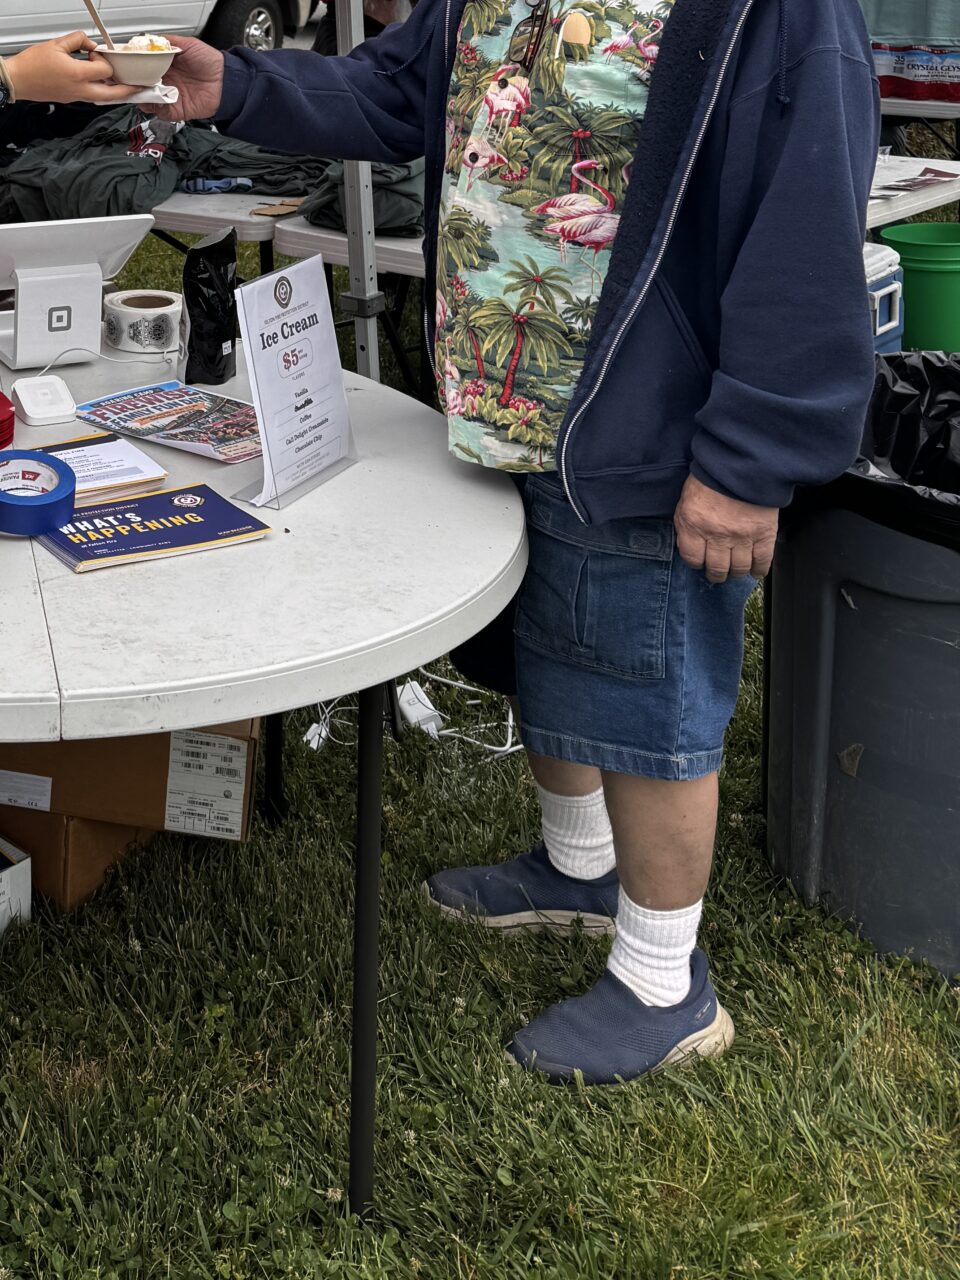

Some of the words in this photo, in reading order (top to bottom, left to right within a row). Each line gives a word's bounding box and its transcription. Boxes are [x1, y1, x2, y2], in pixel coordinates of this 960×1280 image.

[895, 55, 906, 63] 35
[906, 63, 939, 72] CRYSTAL
[260, 331, 279, 350] Ice
[281, 313, 319, 340] Cream
[282, 348, 299, 372] $5
[88, 387, 198, 422] FIREWISE
[110, 407, 152, 426] FAMILY
[154, 401, 181, 412] FUN
[183, 395, 205, 407] DAY
[59, 512, 142, 534] WHAT'S
[66, 513, 205, 545] HAPPENING
